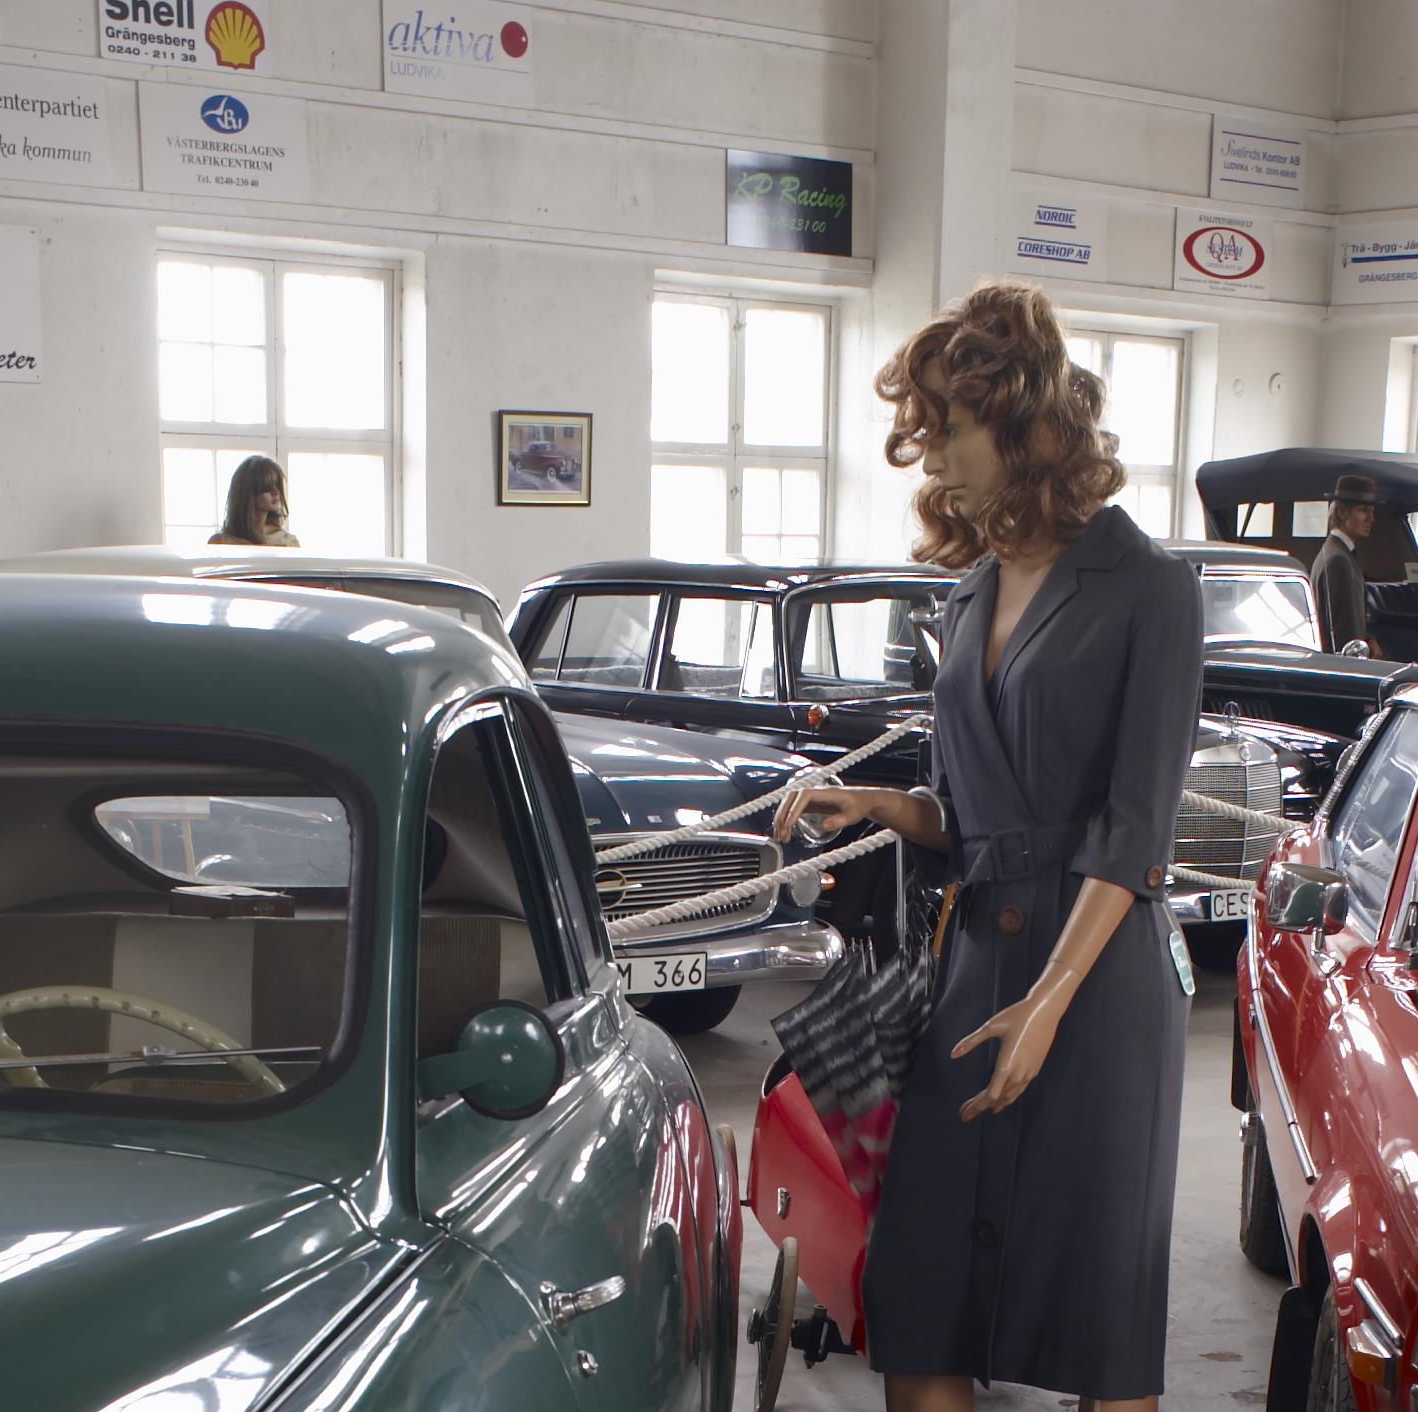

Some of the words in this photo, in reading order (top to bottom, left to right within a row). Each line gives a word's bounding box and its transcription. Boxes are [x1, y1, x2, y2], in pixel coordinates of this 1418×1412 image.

[105, 26, 195, 50] Grängesberg
[388, 9, 494, 63] aktiva
[22, 136, 92, 162] kommun
[166, 135, 286, 158] VÄSTERBERGSLAGENS
[181, 153, 273, 171] TRAFIKCENTRUM
[780, 176, 847, 219] Racing
[1036, 209, 1076, 224] NORDIC
[1018, 241, 1074, 258] CORESHOP
[1075, 248, 1091, 260] AB
[1351, 244, 1366, 253] Trä
[1372, 243, 1397, 253] Bygg
[654, 958, 702, 988] 366
